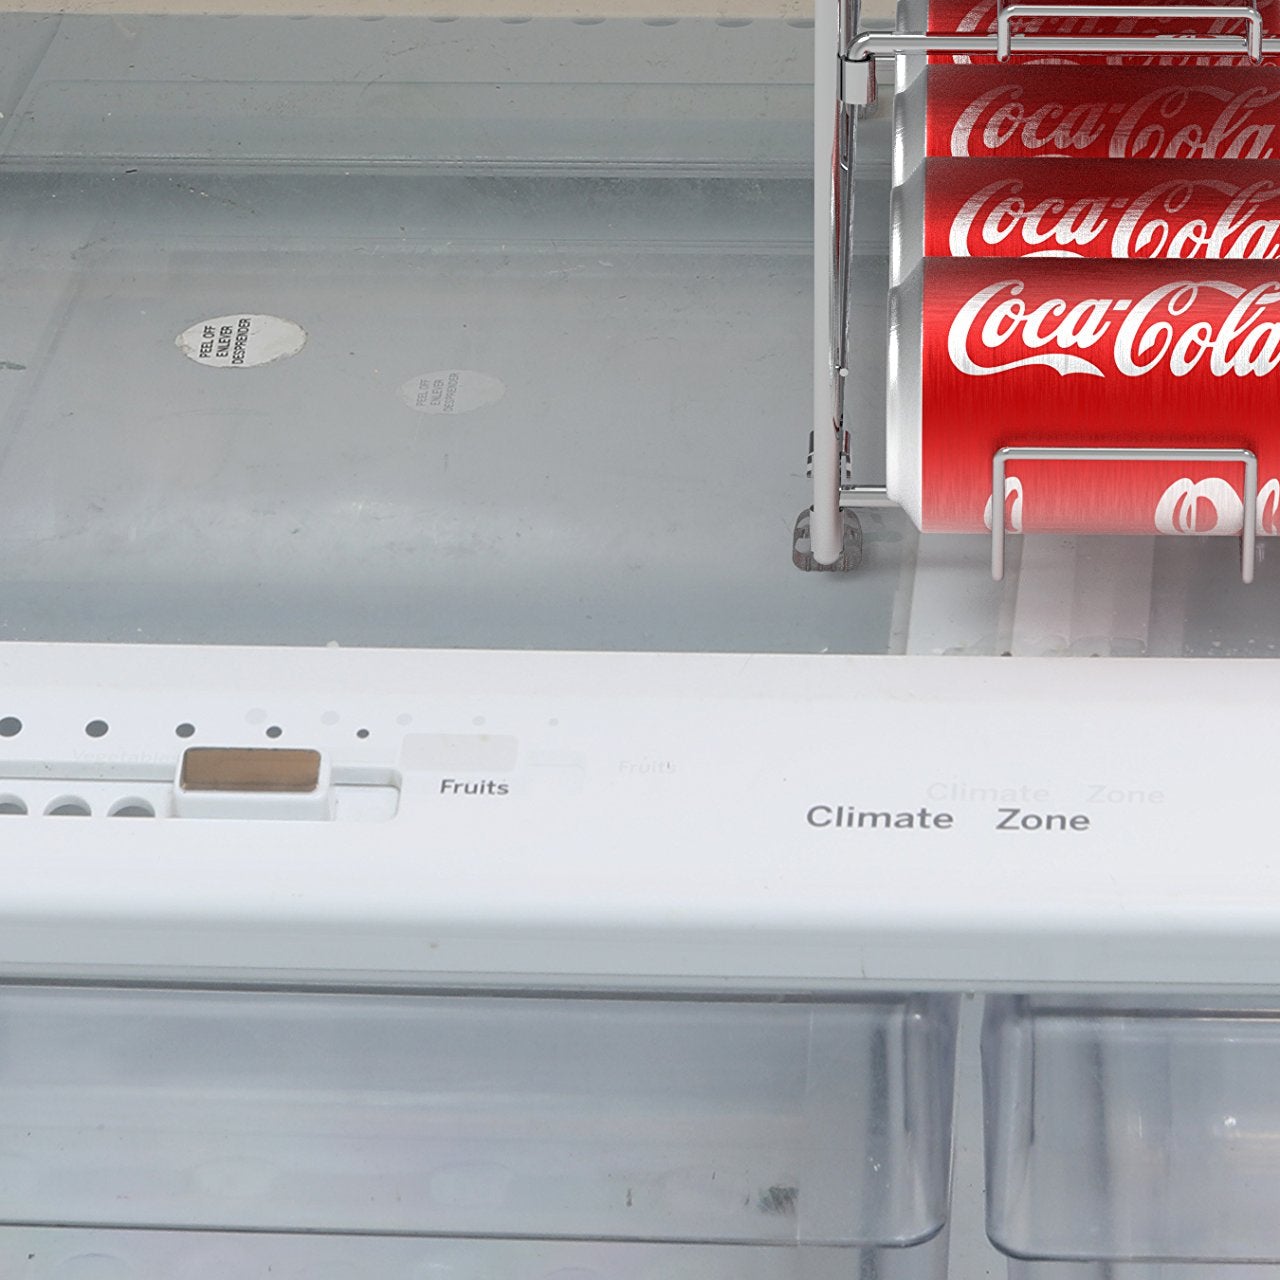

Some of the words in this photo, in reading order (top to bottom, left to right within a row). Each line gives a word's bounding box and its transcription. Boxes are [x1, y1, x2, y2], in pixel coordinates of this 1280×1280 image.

[202, 325, 216, 339] OFF
[216, 325, 233, 357] ENLEVER
[199, 339, 214, 358] PEEL
[439, 779, 510, 796] Fruits
[806, 805, 954, 830] Climate
[995, 808, 1090, 831] Zone
